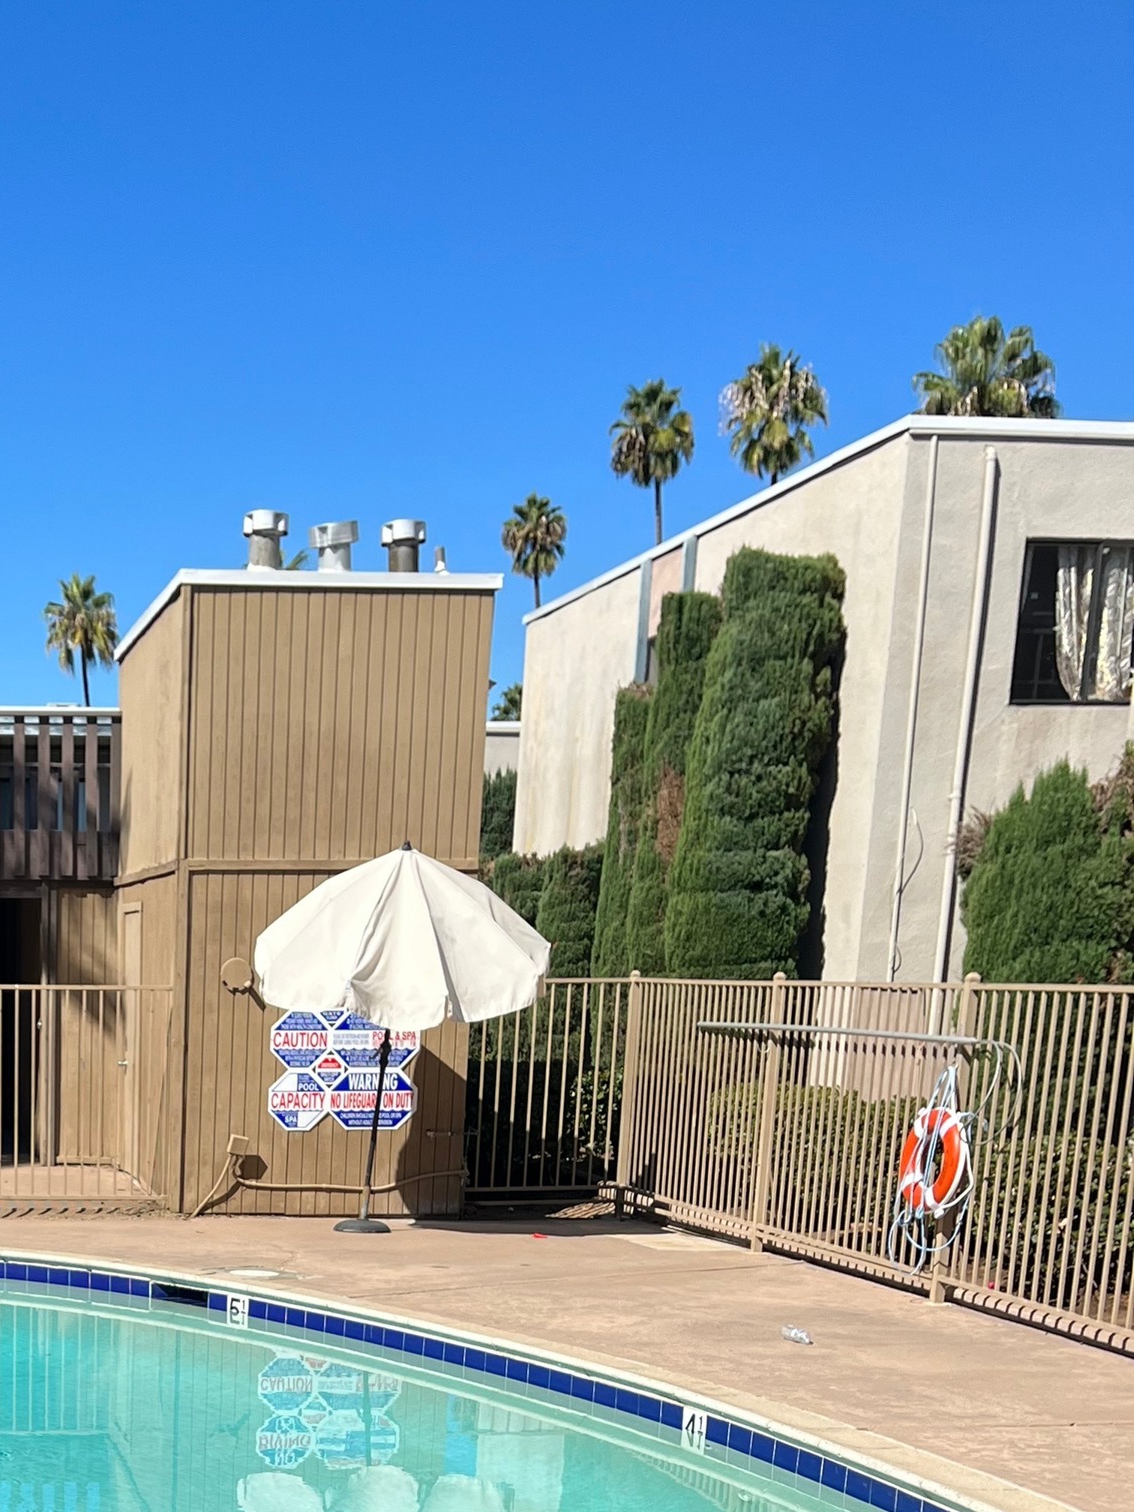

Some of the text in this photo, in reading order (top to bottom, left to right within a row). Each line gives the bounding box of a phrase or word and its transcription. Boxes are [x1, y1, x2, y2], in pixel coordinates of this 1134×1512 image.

[273, 1032, 328, 1048] CAUTION
[298, 1083, 319, 1091] POOL
[348, 1073, 399, 1090] WARNNG
[271, 1092, 326, 1109] CAPACITY
[330, 1092, 341, 1108] NO
[343, 1092, 377, 1108] LIFEGUAR
[383, 1092, 394, 1108] ON
